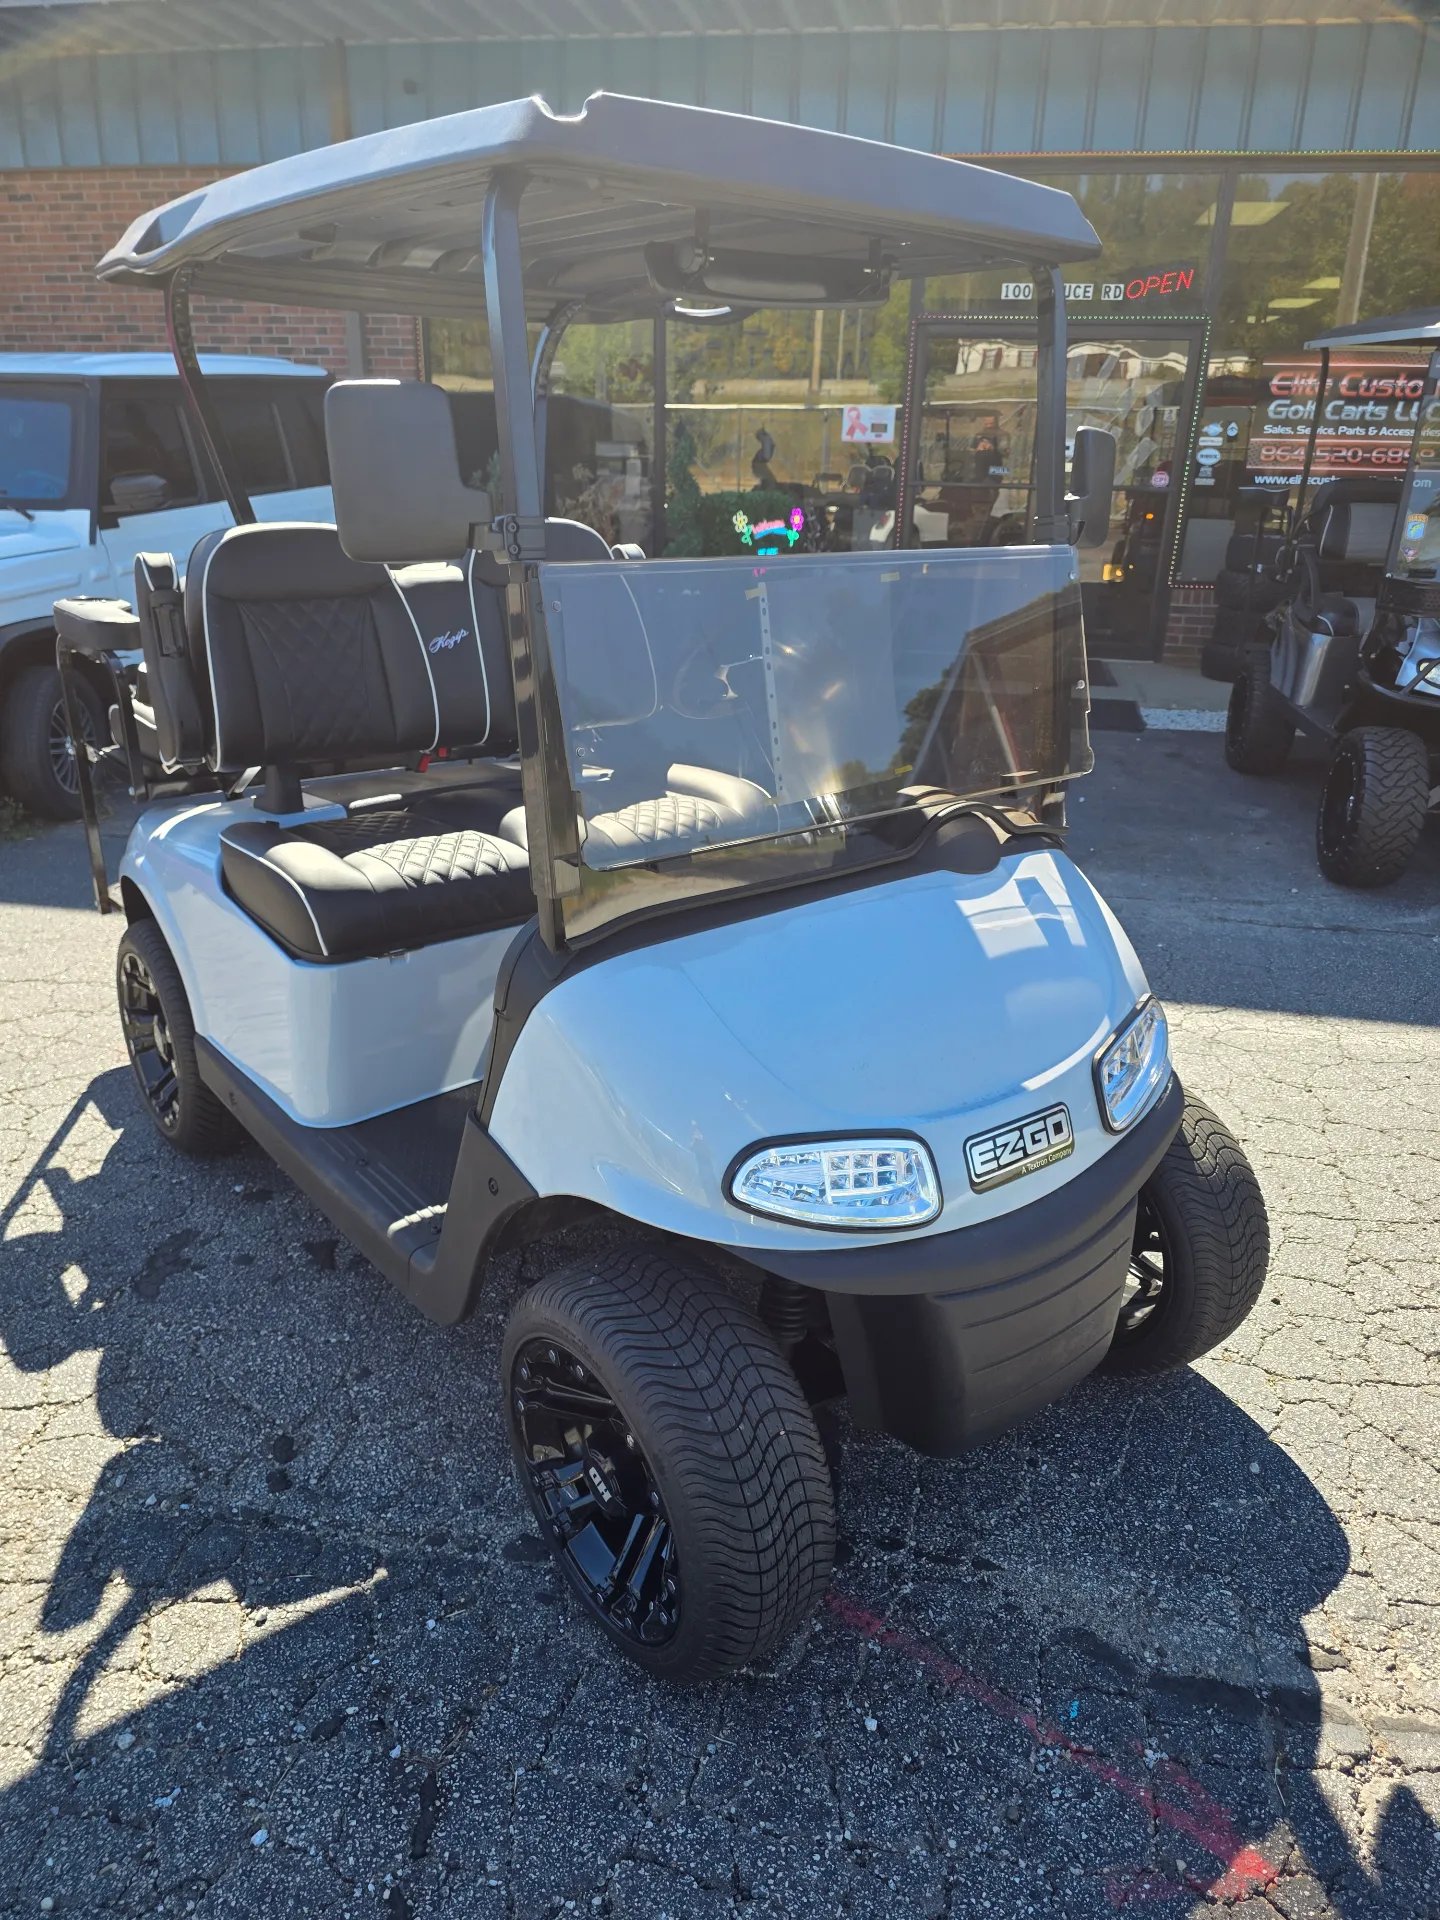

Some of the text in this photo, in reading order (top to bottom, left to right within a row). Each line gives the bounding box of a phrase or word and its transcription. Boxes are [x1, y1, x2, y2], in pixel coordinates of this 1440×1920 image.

[1003, 284, 1031, 298] 100
[1103, 285, 1123, 299] RD
[1126, 269, 1194, 299] OPEN
[1269, 371, 1333, 396] Elite
[1325, 400, 1388, 421] Carts
[1296, 425, 1336, 436] Seice,
[1338, 426, 1366, 436] Parts
[1368, 426, 1377, 436] &
[1379, 427, 1440, 437] Accessries
[1021, 1148, 1072, 1174] A Textron Company
